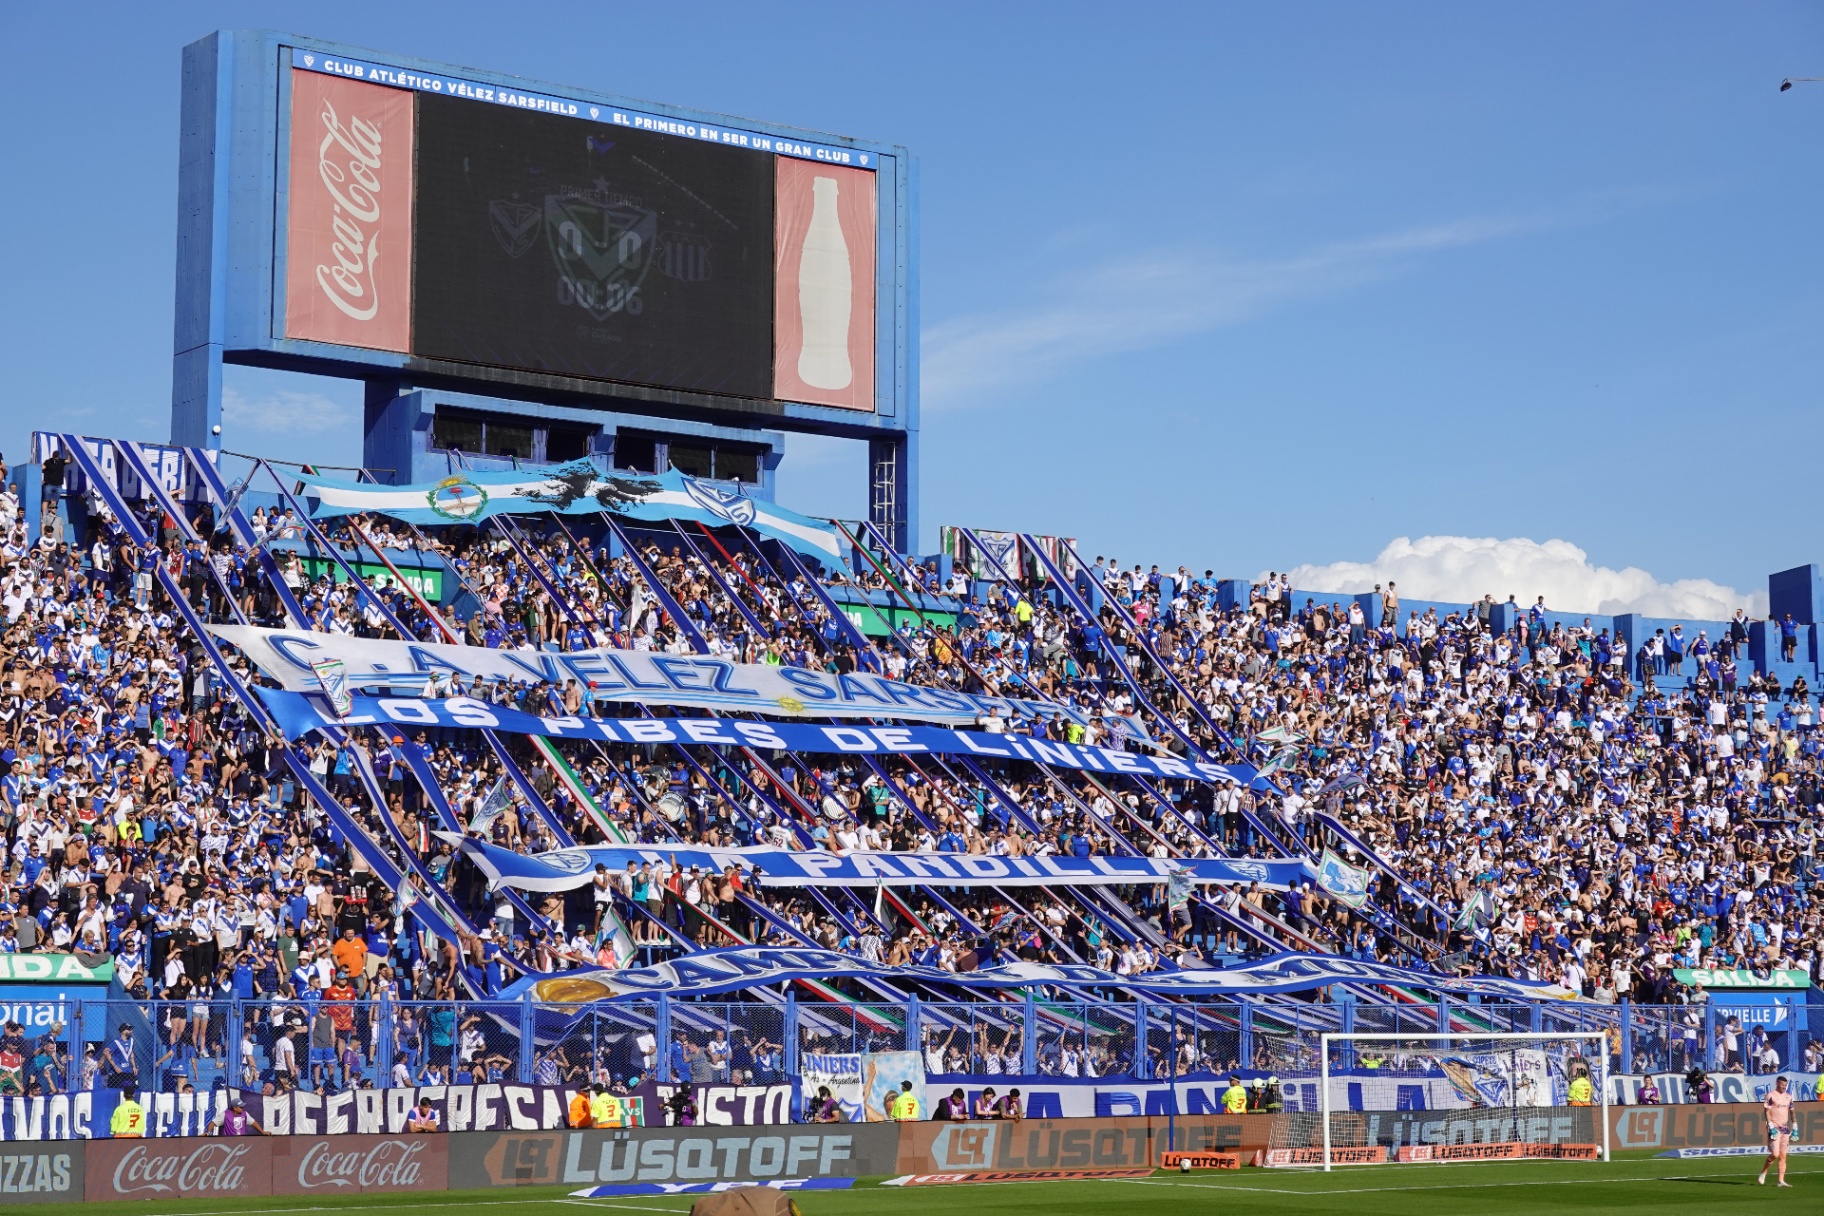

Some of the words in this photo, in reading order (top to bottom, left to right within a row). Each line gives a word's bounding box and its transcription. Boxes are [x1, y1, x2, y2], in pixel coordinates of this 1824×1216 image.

[324, 59, 363, 77] CLUB
[369, 68, 442, 91] ATLÉTICO
[447, 80, 494, 101] VÉLEZ
[498, 92, 578, 116] SARSFIELD
[613, 112, 630, 125] EL
[635, 116, 696, 136] PRIMERO
[700, 128, 718, 140] EN
[723, 131, 748, 147] SER
[752, 137, 771, 150] UN
[775, 141, 811, 157] GRAN
[816, 148, 850, 163] CLUB
[316, 96, 383, 321] Coca-Cola
[820, 727, 928, 752] DE
[0, 1090, 92, 1141] MOS
[113, 1143, 252, 1194] Coca-Cola
[298, 1140, 428, 1188] Coca-Cola
[563, 1131, 852, 1184] LÜSQTOFF
